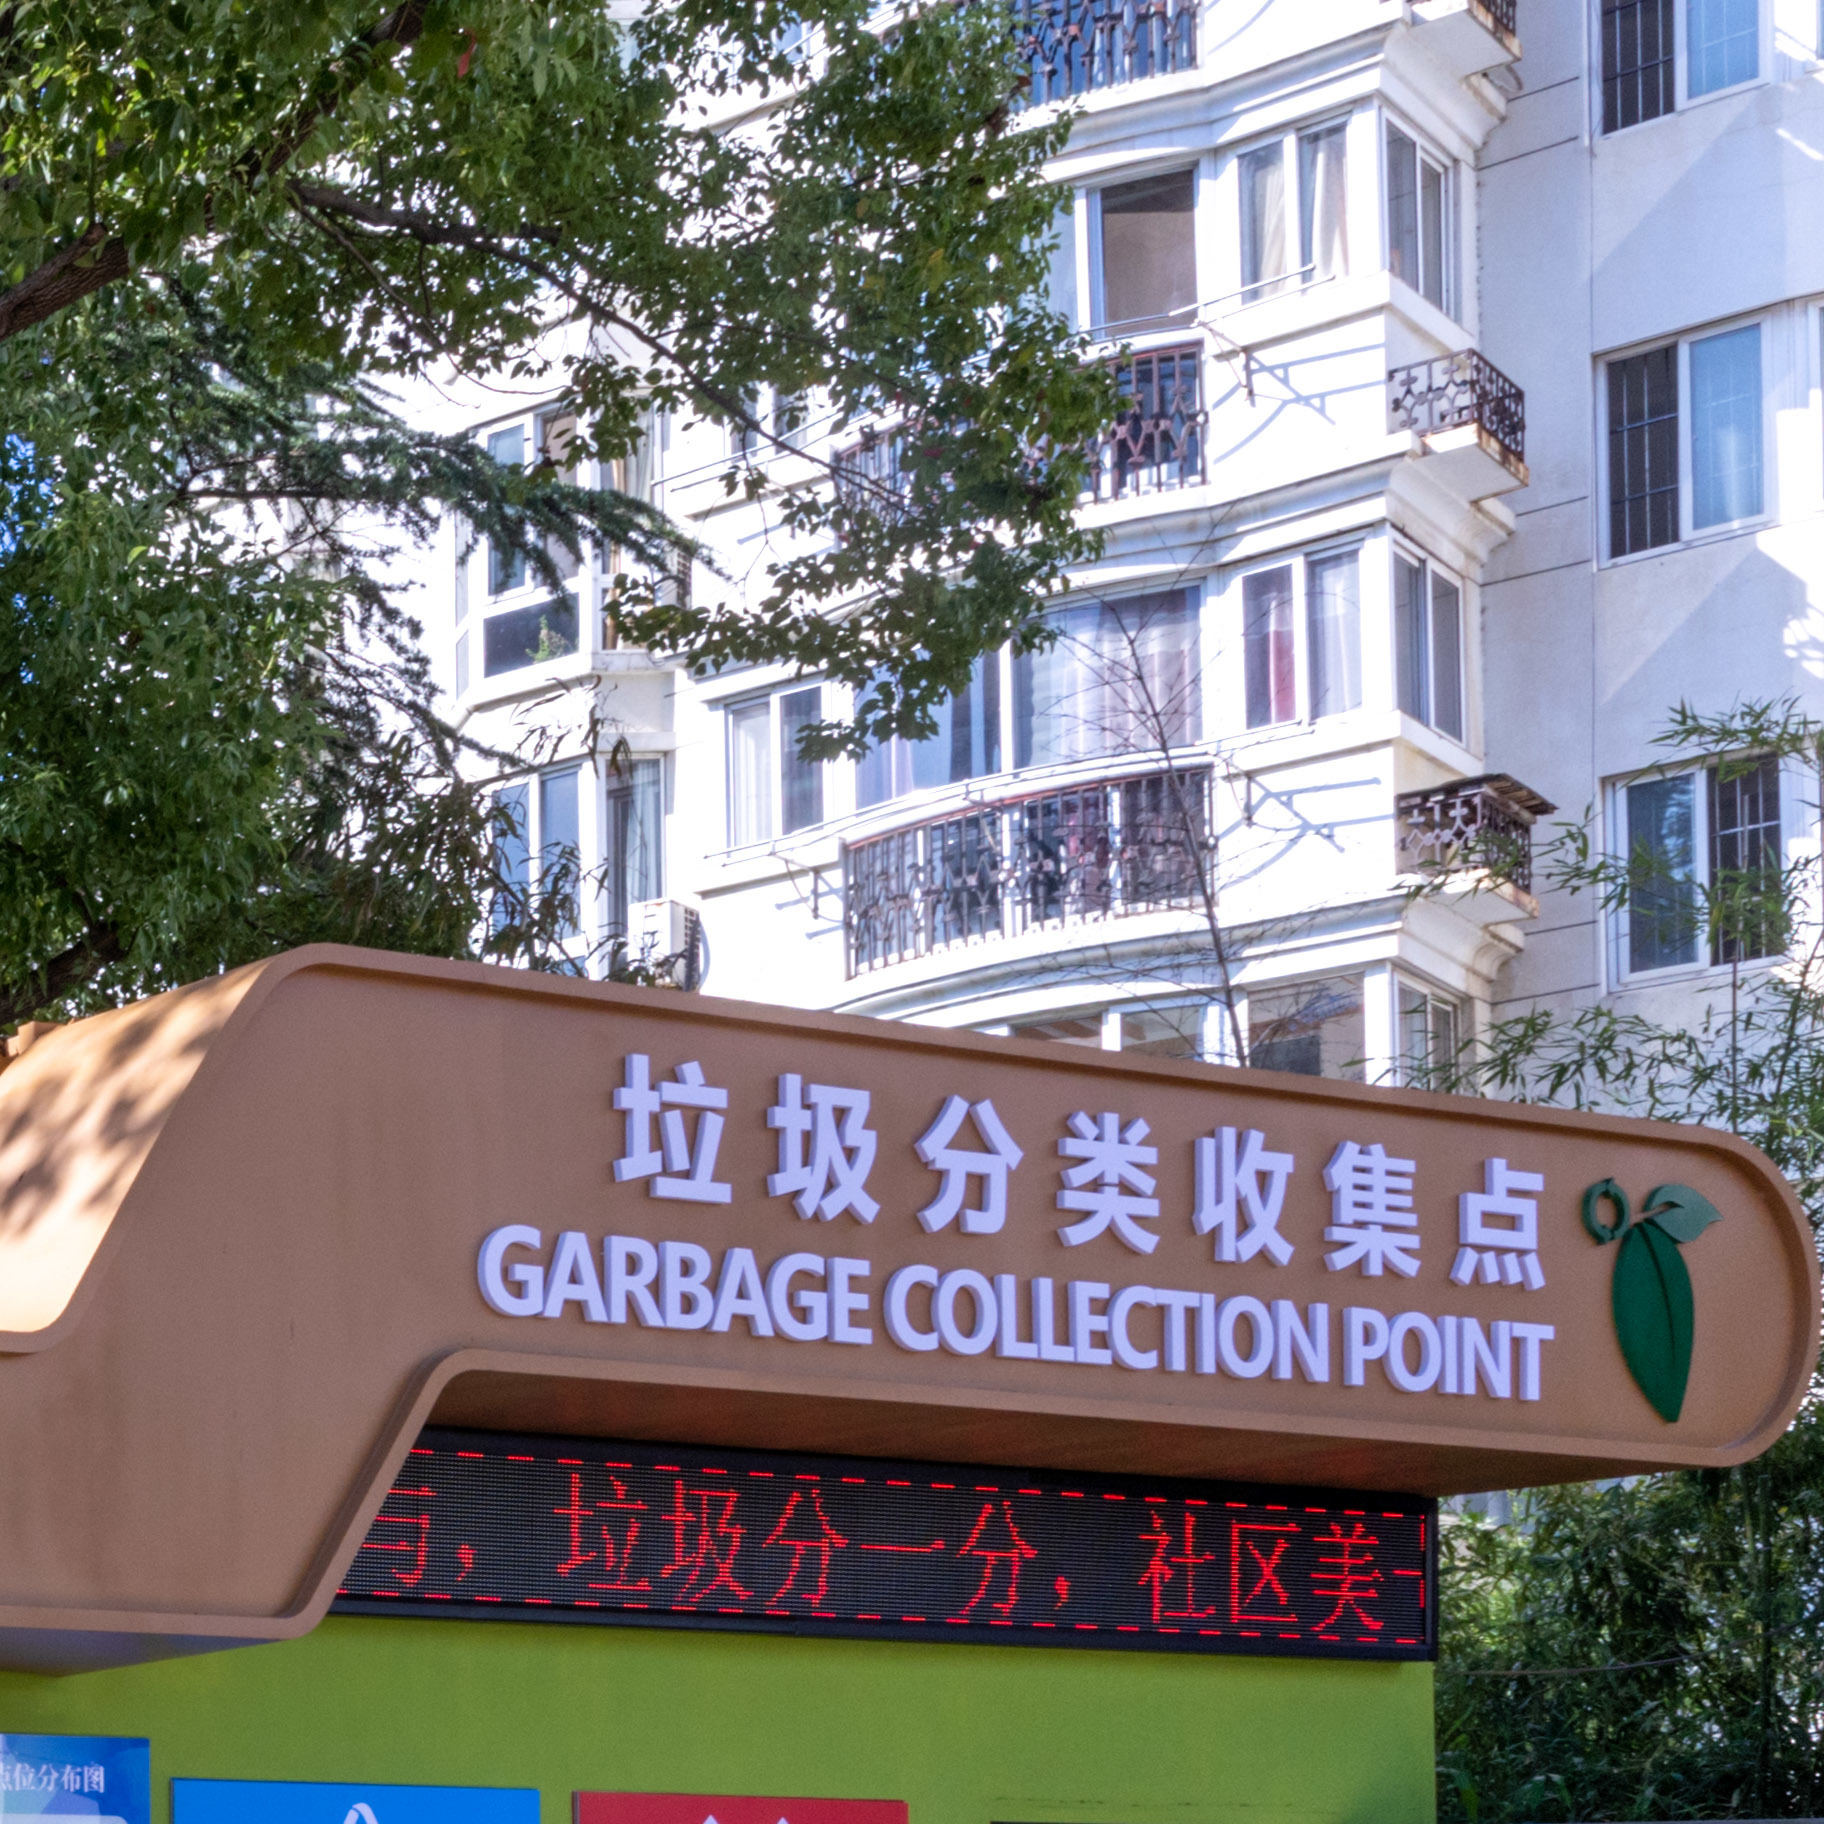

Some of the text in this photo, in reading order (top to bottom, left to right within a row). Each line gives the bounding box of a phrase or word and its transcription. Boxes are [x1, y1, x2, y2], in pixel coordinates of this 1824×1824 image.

[614, 1052, 1548, 1290] 垃圾分类收集点
[478, 1225, 1554, 1400] GARBAGE COLLECTION POINT
